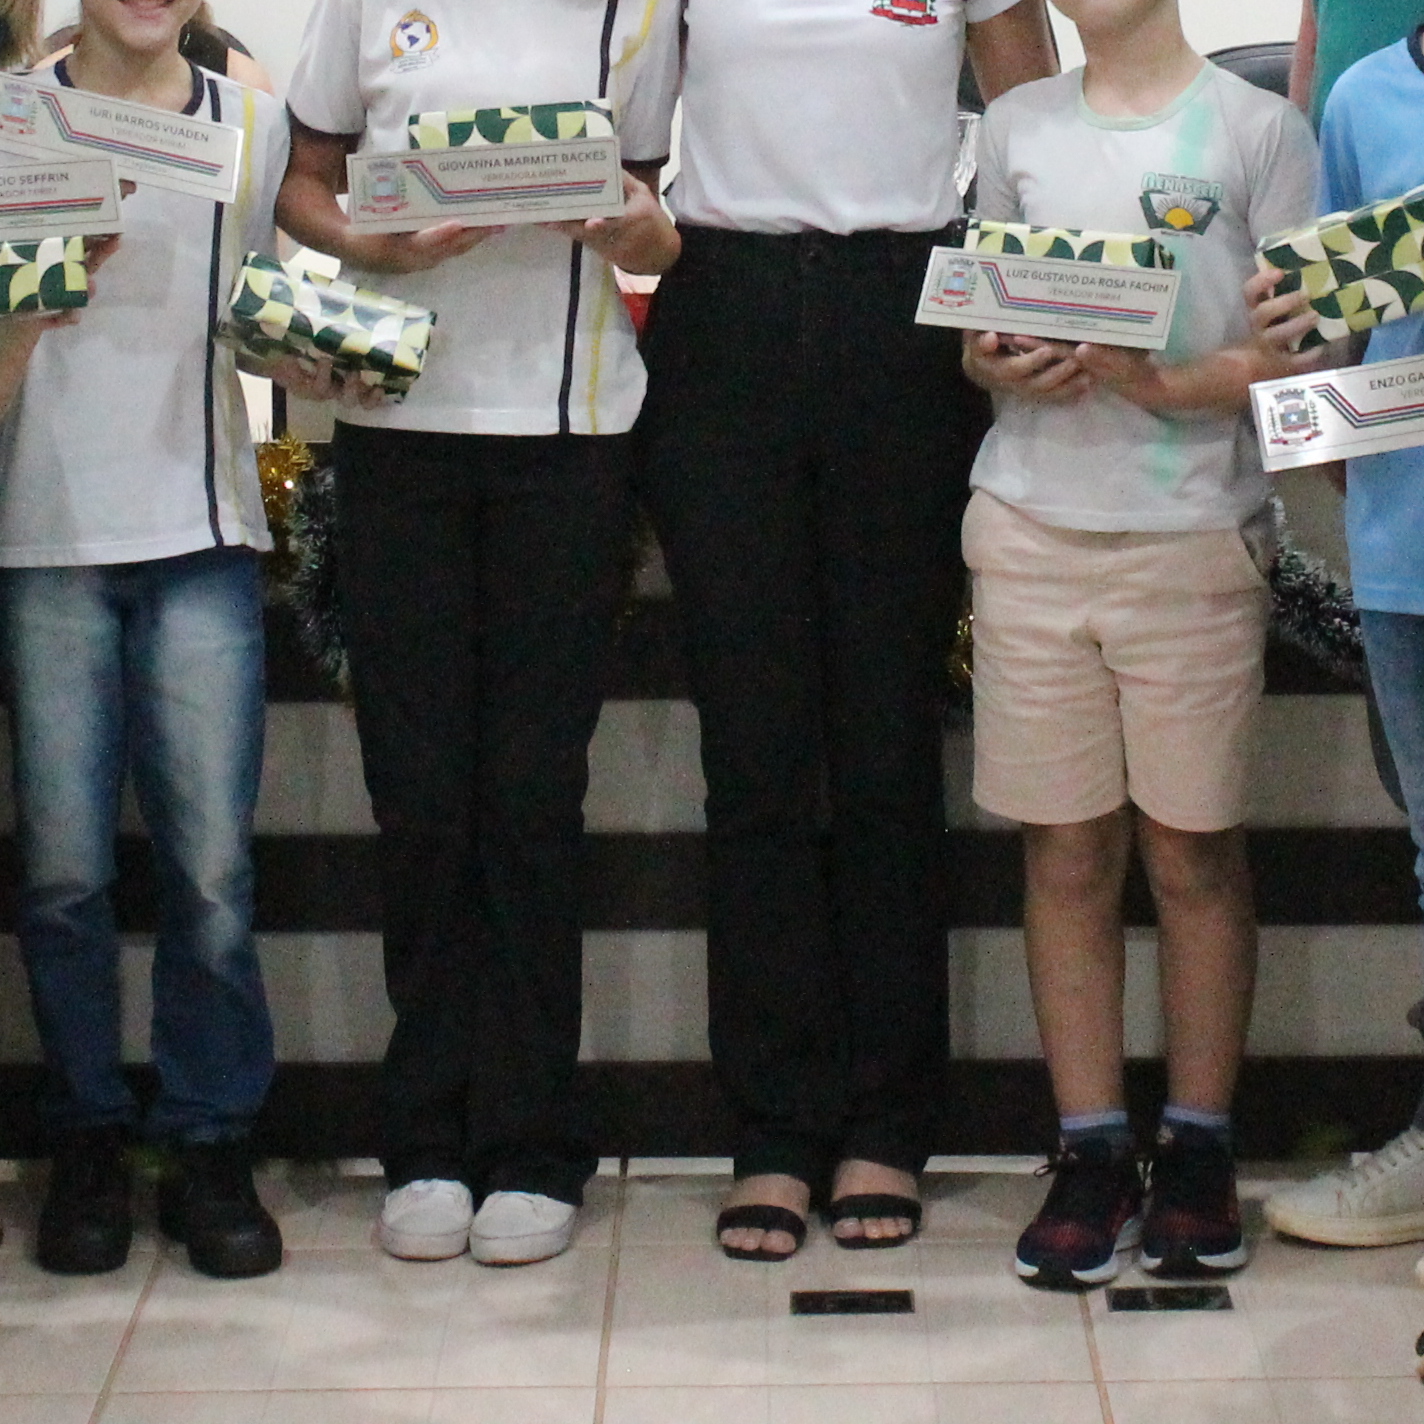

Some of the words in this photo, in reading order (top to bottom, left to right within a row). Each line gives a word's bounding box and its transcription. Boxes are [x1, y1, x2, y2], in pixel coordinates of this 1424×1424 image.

[116, 113, 160, 131] BARROS
[438, 158, 501, 172] GIOVANNA
[504, 154, 559, 167] MARMITT
[561, 150, 607, 162] BACKES
[19, 173, 70, 186] SEFFRIN
[1006, 269, 1029, 279] LUIZ
[1031, 271, 1080, 284] GUSTAVO
[1081, 276, 1096, 286] DA
[1098, 278, 1127, 288] ROSA
[1370, 375, 1405, 390] ENZO
